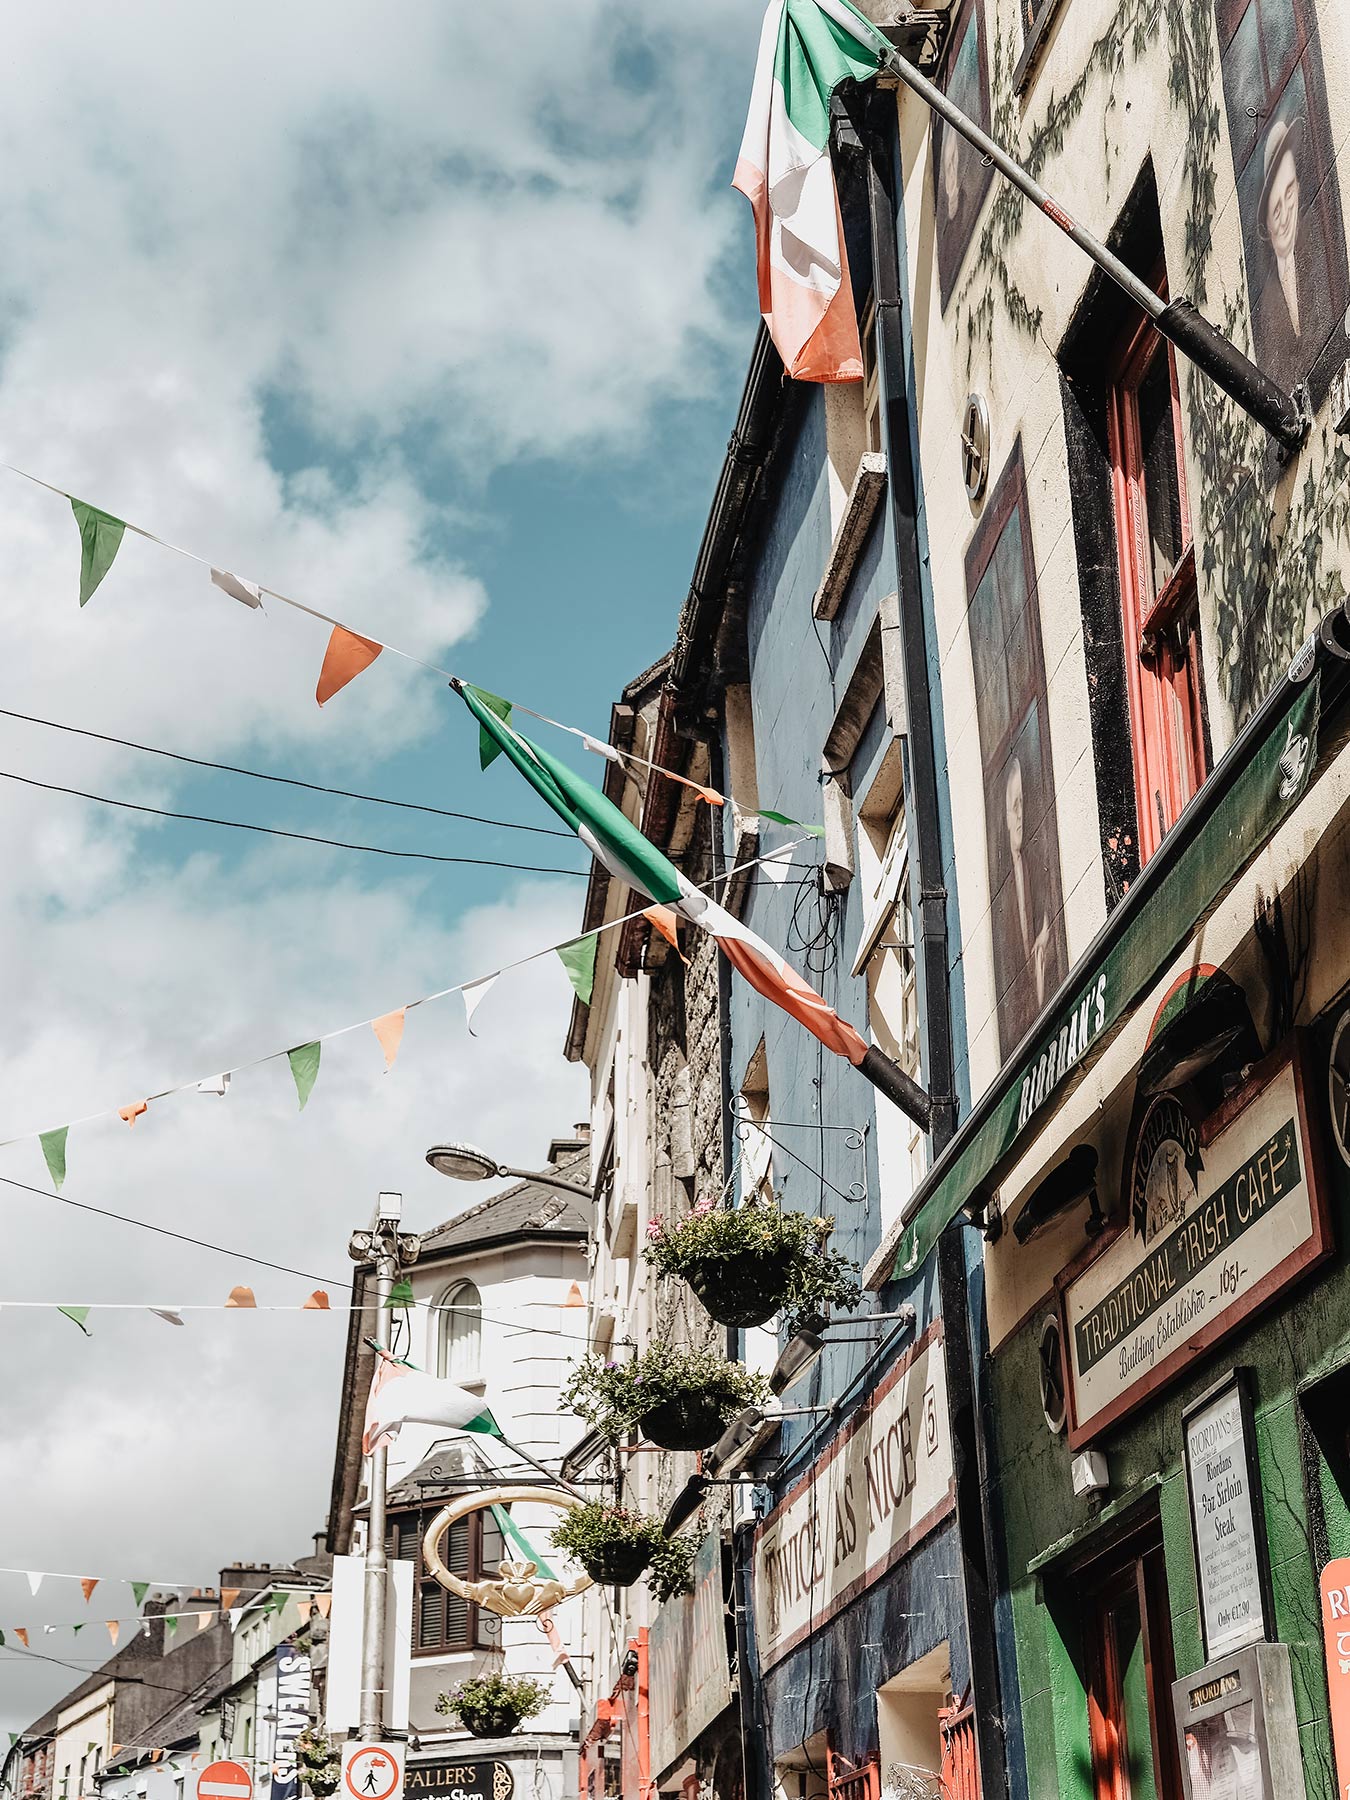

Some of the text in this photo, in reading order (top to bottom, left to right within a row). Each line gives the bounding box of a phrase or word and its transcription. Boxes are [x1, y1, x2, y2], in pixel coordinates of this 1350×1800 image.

[1018, 973, 1107, 1131] RIORDAN'S
[1134, 1103, 1197, 1212] RIORDAN'S
[1082, 1248, 1176, 1361] TRADITIONAL
[1179, 1194, 1230, 1272] IRISH
[1118, 1333, 1155, 1379] Building
[1157, 1288, 1206, 1350] Established
[928, 1398, 935, 1445] 5
[1206, 1454, 1232, 1482] Riordans
[1216, 1473, 1243, 1508] Sirloin
[764, 1407, 917, 1634] TWICE AS NICE
[1214, 1508, 1236, 1541] Steak
[1217, 1609, 1231, 1628] Only
[404, 1766, 476, 1789] FALLER'S
